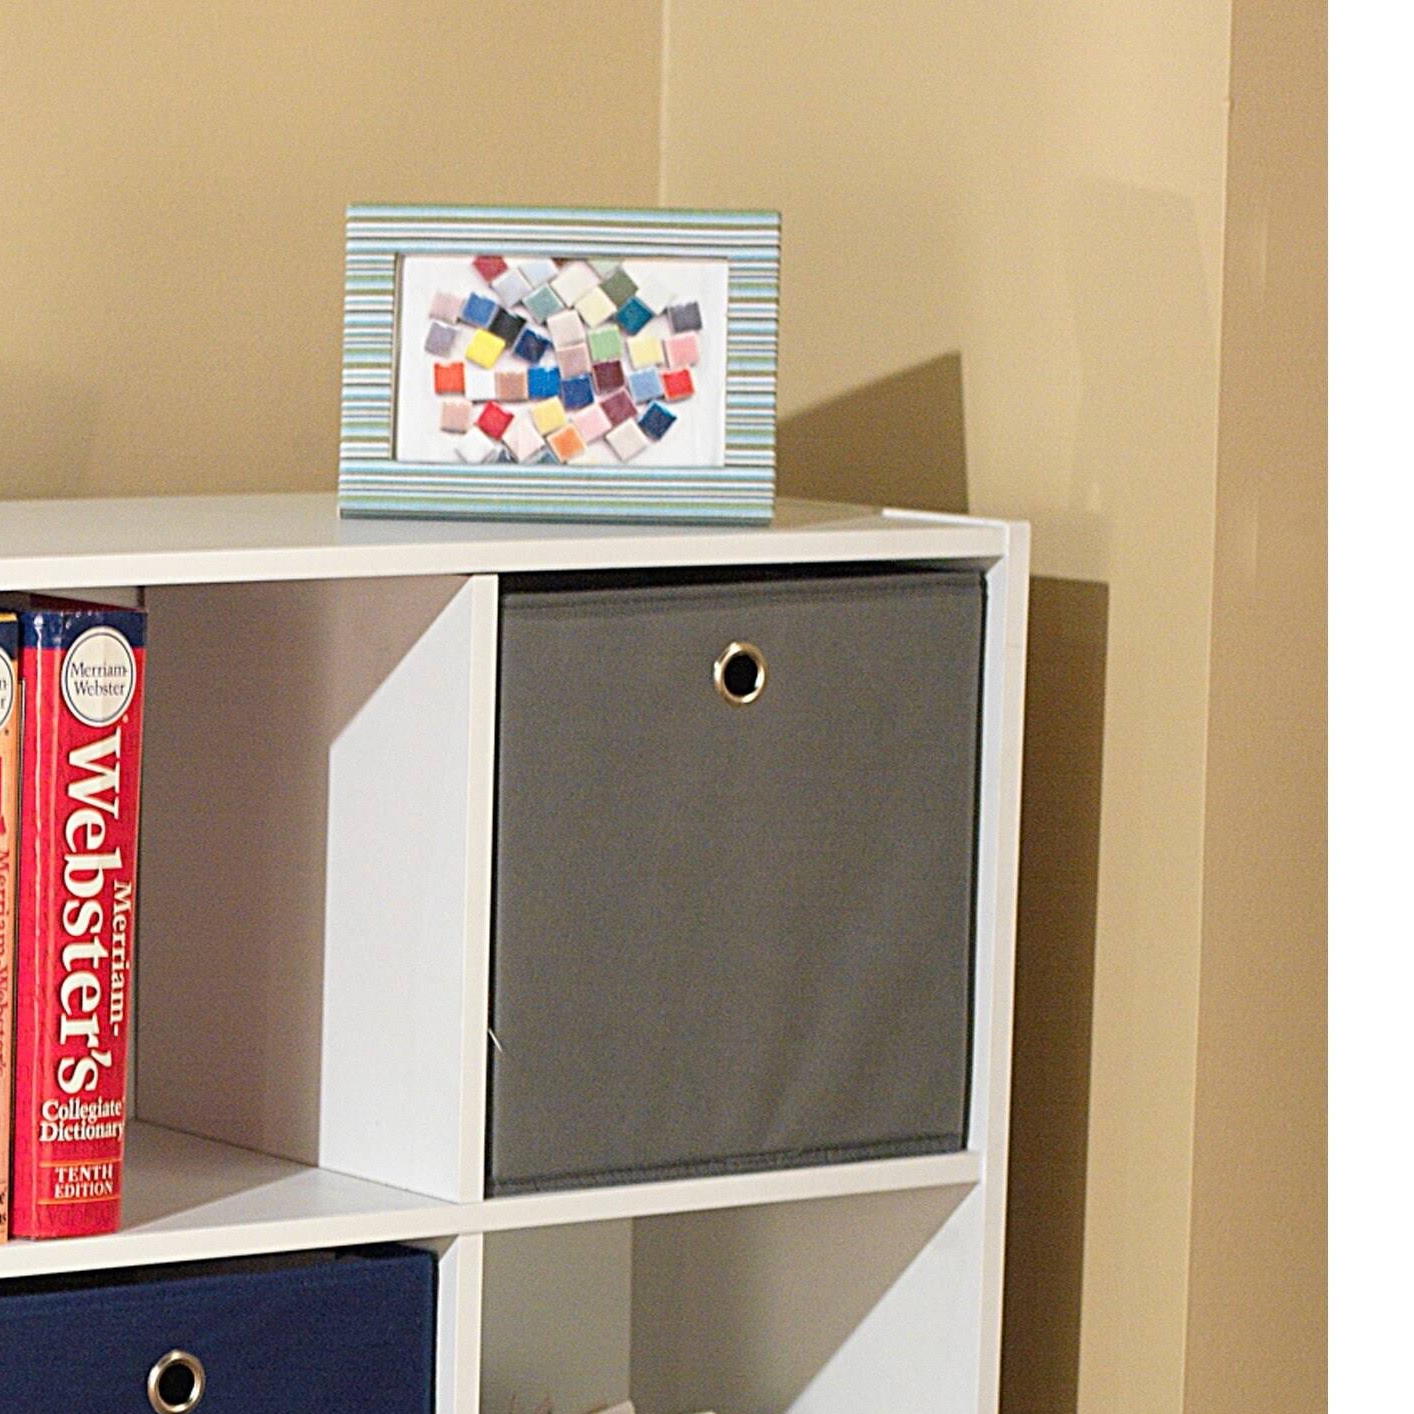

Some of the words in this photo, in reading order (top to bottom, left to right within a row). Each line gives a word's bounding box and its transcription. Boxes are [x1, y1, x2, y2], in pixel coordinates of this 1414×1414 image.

[74, 679, 126, 697] Webster
[57, 728, 123, 1095] Webster's
[110, 879, 132, 1036] Merriam-
[42, 1096, 123, 1123] Collegiate
[39, 1119, 124, 1142] Dictionary
[54, 1163, 113, 1183] TENTH
[54, 1181, 113, 1199] EDITION
